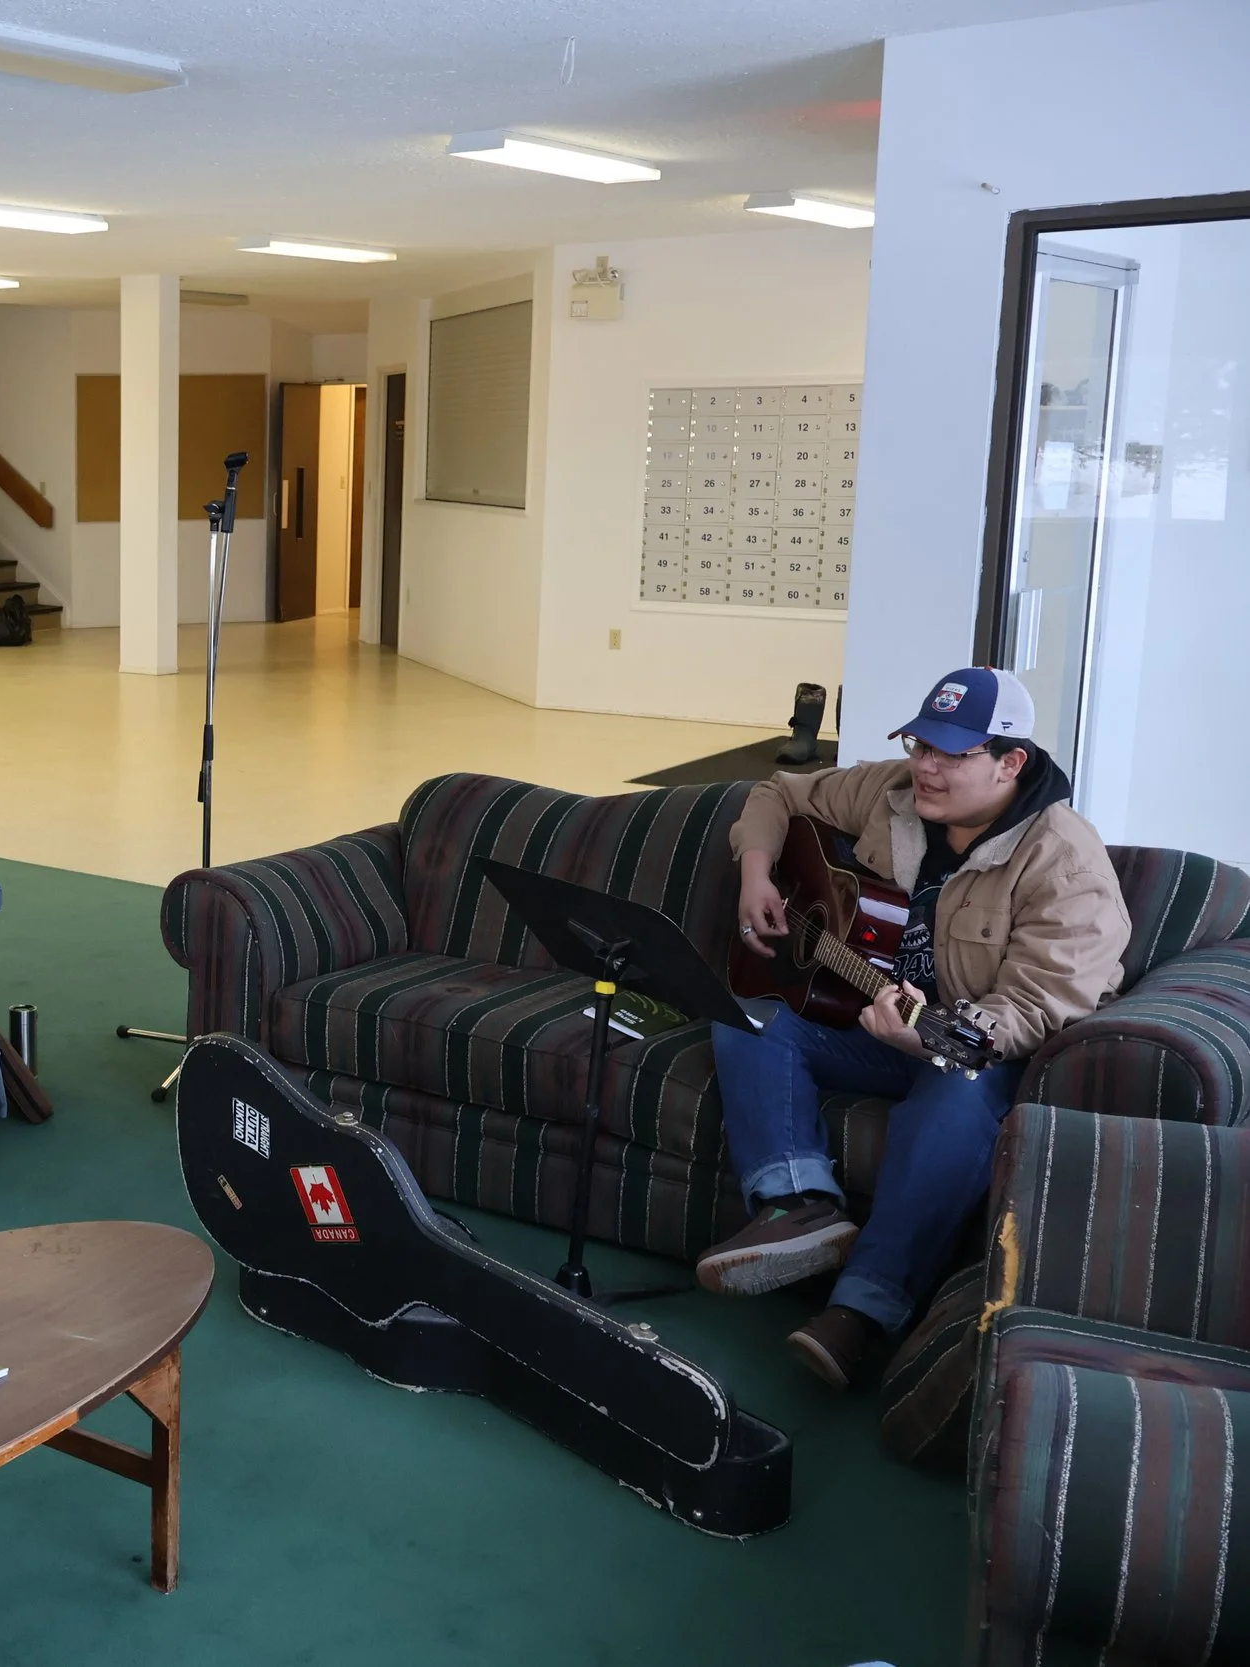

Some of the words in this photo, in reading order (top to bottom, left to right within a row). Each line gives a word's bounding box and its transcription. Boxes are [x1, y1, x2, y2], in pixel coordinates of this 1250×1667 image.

[711, 397, 716, 405] 2
[757, 397, 762, 405] 3
[802, 395, 807, 403] 4
[849, 394, 855, 402] 5
[753, 424, 763, 432] 11
[846, 423, 856, 431] 13
[751, 452, 761, 460] 19
[797, 452, 808, 460] 20
[842, 480, 853, 488] 29
[838, 537, 849, 545] 45
[836, 564, 846, 572] 53
[834, 592, 844, 600] 61
[894, 953, 935, 981] JAW
[615, 1012, 636, 1025] Sing
[620, 1008, 645, 1023] LORD
[236, 1099, 244, 1139] KIKINO
[248, 1108, 257, 1145] OUTTA
[260, 1114, 270, 1158] STRAIGHT
[315, 1228, 356, 1240] CANADA
